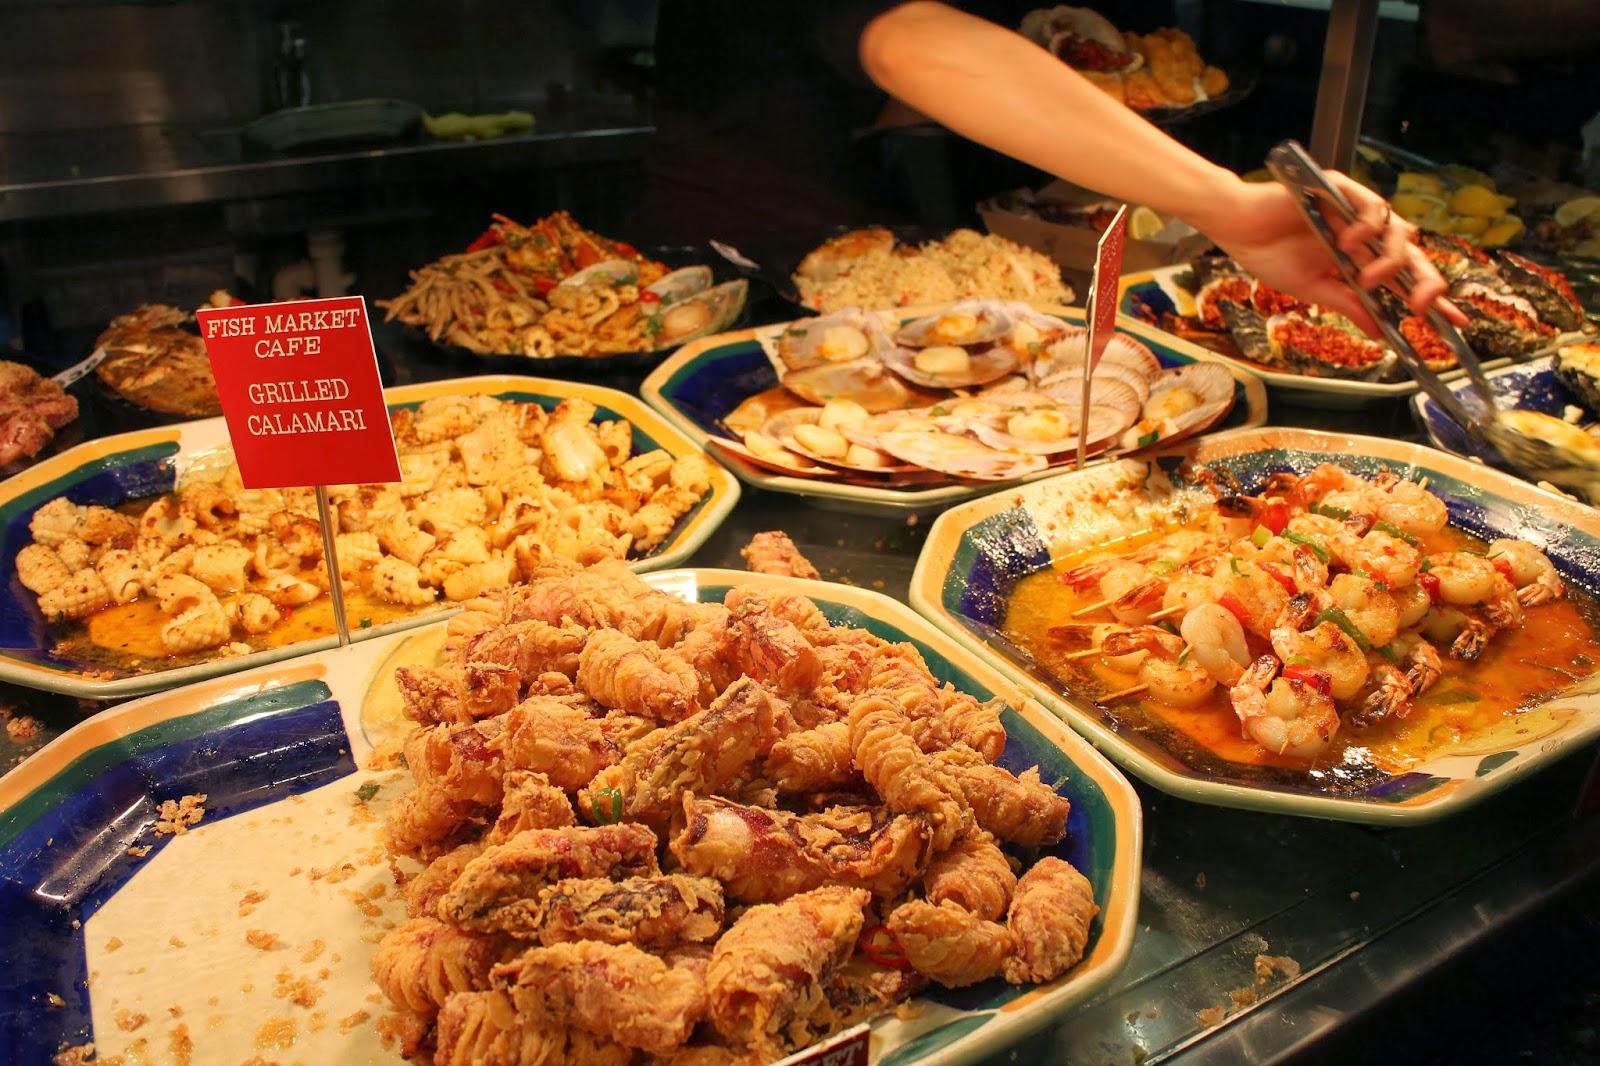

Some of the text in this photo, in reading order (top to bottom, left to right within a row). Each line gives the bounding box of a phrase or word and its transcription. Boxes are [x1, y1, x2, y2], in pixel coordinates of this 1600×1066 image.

[207, 308, 361, 339] FISH MARKET
[254, 336, 321, 359] CAFE
[248, 378, 350, 405] GRILLED
[247, 409, 367, 436] CALAMARI
